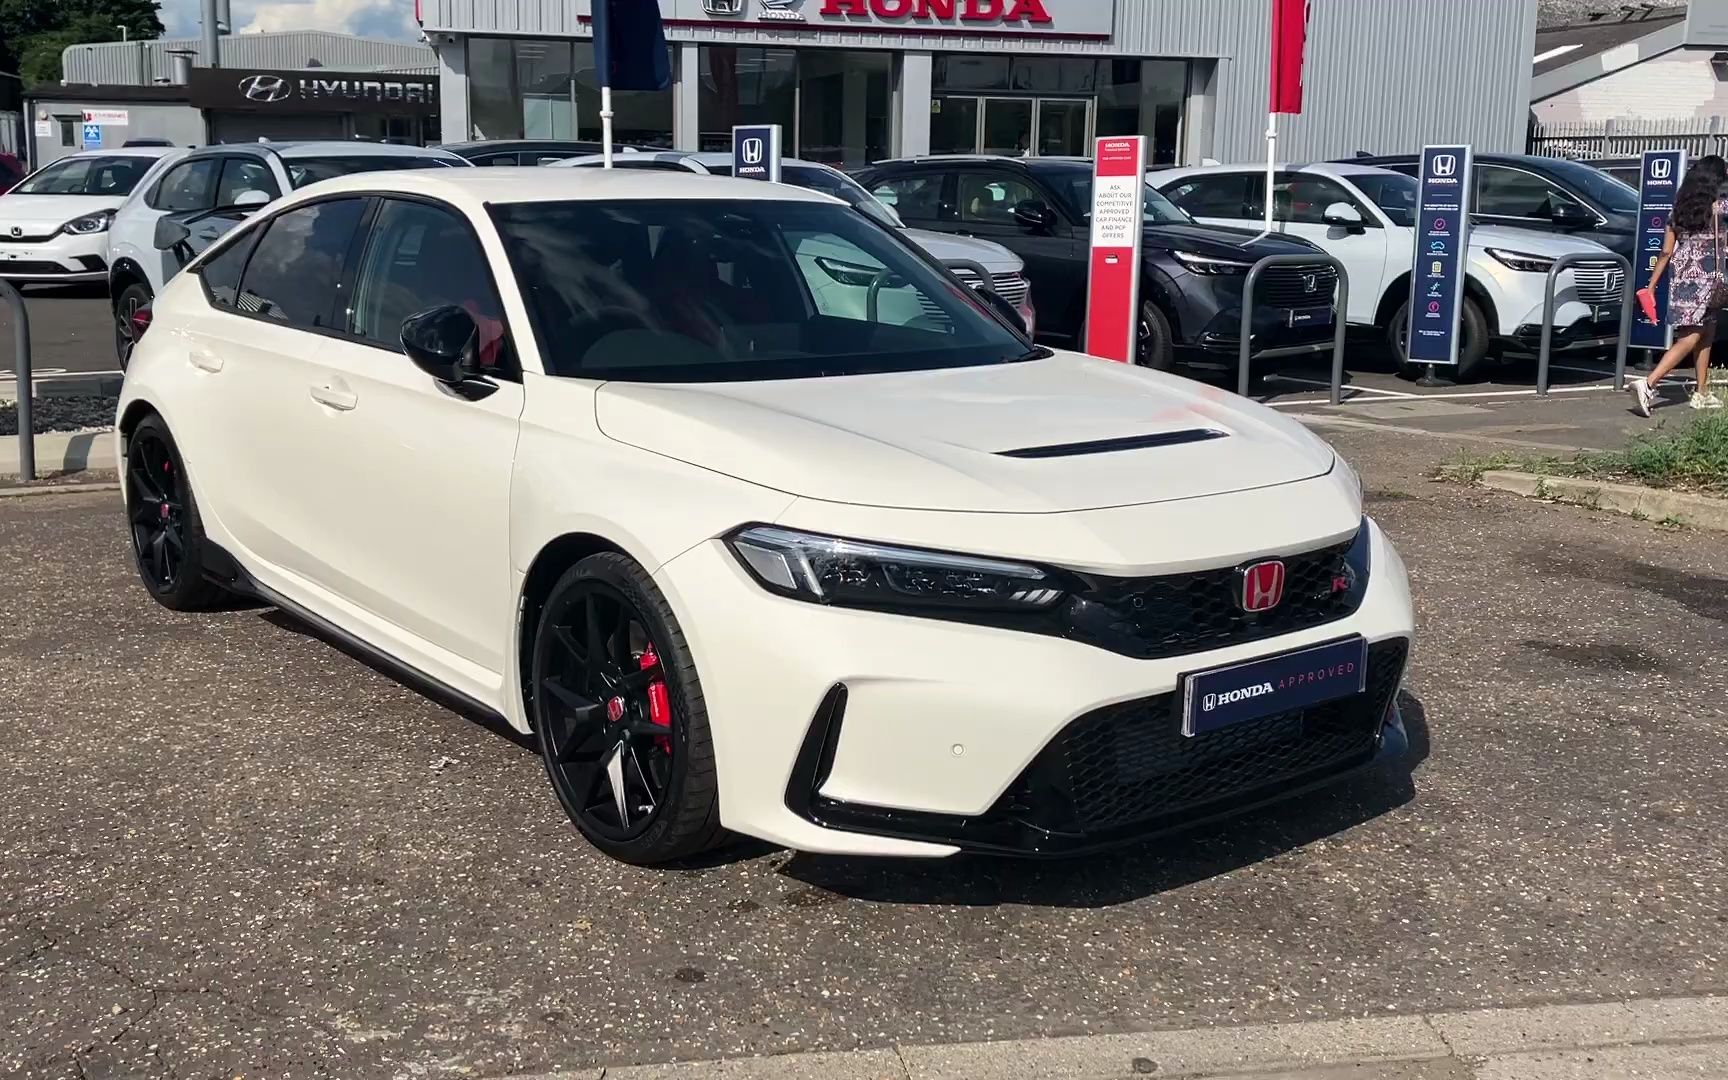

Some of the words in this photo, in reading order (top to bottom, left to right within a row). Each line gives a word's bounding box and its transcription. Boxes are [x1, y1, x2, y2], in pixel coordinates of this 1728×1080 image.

[300, 79, 433, 103] HYUNDAI
[1331, 576, 1348, 592] R
[1217, 682, 1274, 706] HONDA
[1278, 662, 1354, 689] APPROVED
